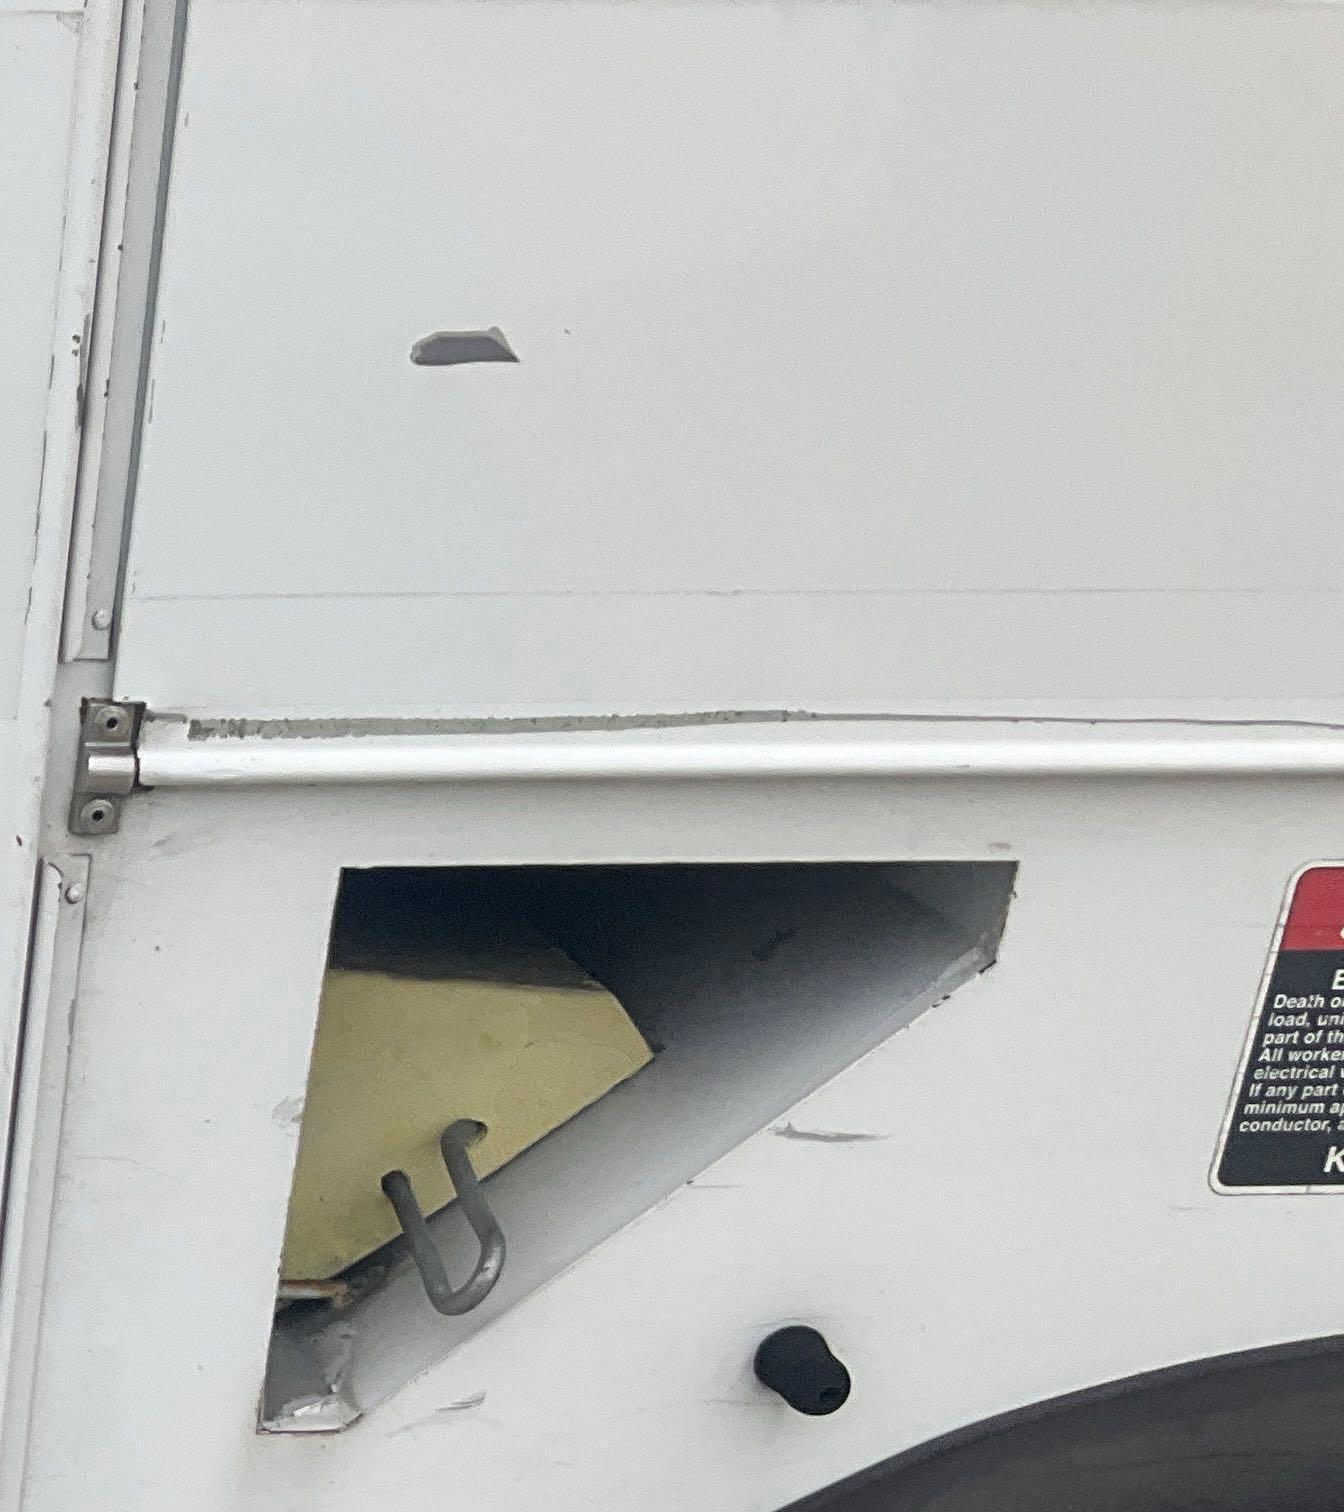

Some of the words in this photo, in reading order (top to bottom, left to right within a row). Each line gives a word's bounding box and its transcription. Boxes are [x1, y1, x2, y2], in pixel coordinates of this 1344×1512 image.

[1273, 993, 1325, 1008] Death
[1262, 1030, 1299, 1047] part
[1303, 1029, 1323, 1044] of
[1258, 1047, 1284, 1062] All
[1253, 1065, 1336, 1080] electrical
[1248, 1083, 1263, 1098] If
[1265, 1085, 1299, 1100] any
[1301, 1083, 1339, 1100] part
[1243, 1100, 1326, 1114] minimum
[1239, 1117, 1332, 1134] conductor,
